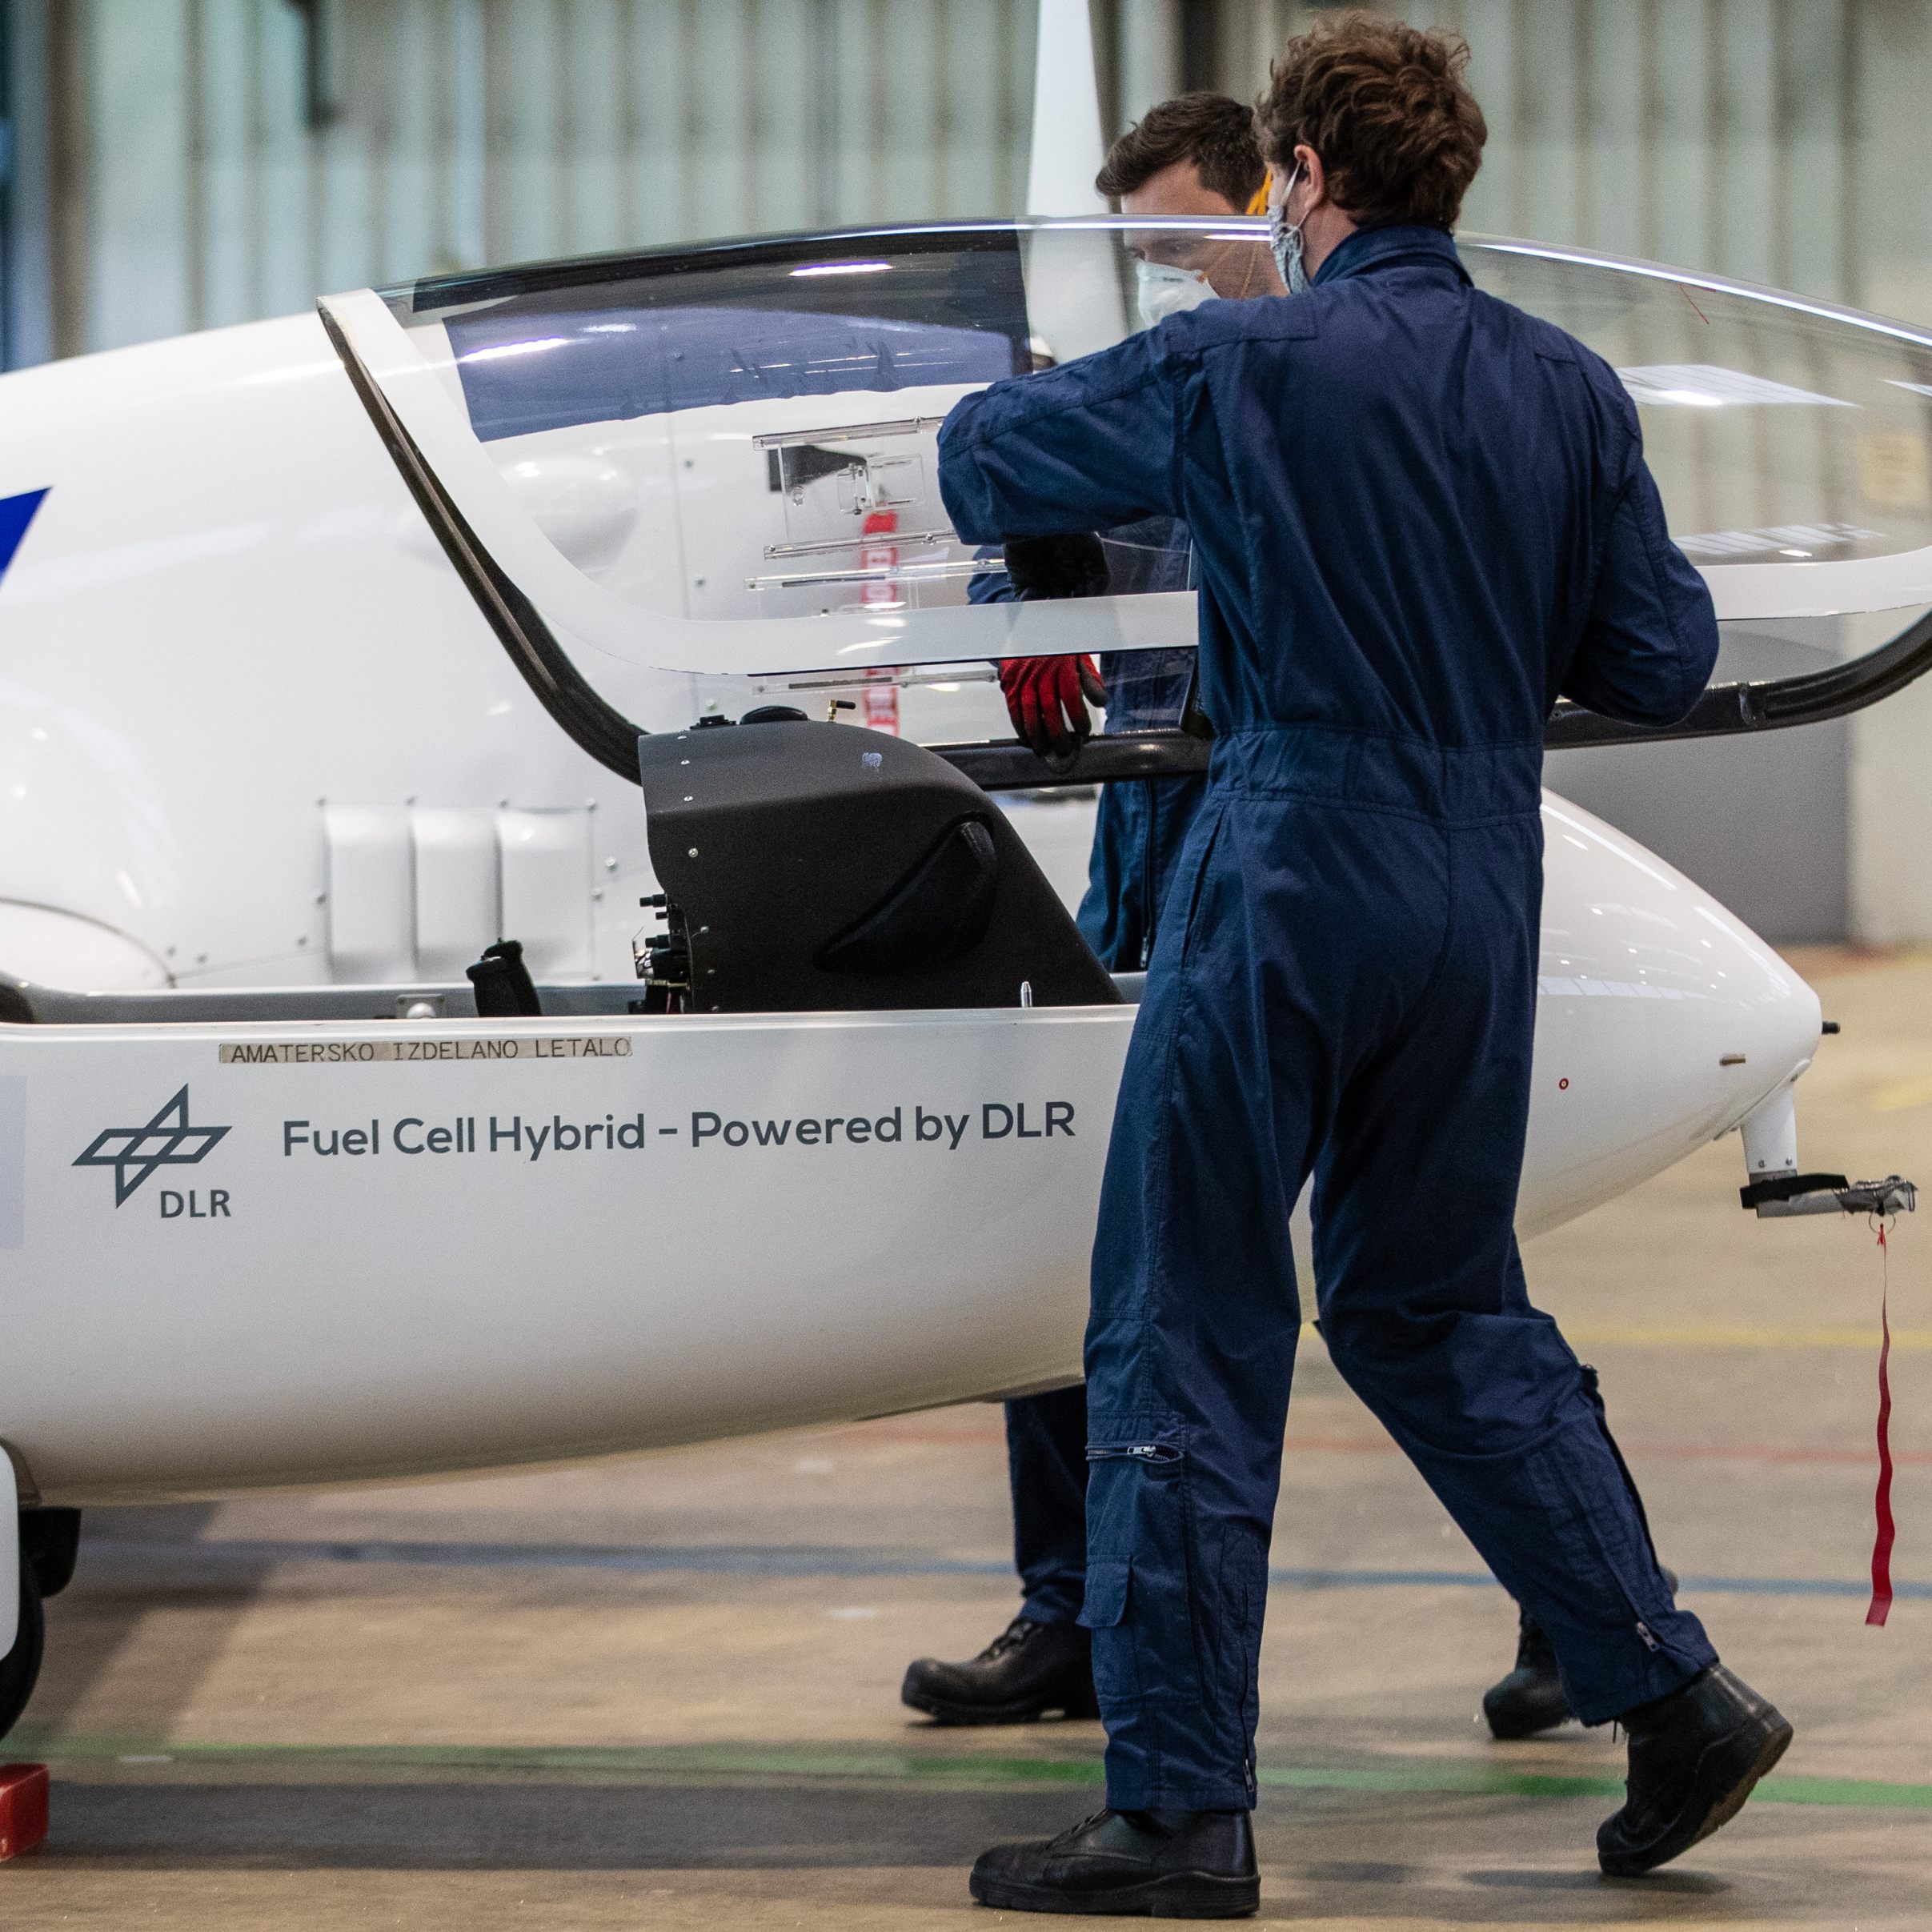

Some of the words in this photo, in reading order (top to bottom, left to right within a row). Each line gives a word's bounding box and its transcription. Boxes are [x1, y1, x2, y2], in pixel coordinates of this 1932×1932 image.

[230, 1043, 375, 1063] AMATERSKO
[393, 1040, 519, 1060] IZDELANO
[535, 1037, 631, 1058] LETALO
[283, 1119, 379, 1156] Fuel
[393, 1116, 475, 1155] Cell
[490, 1113, 645, 1161] Hybrid
[691, 1106, 902, 1148] Powered
[915, 1105, 971, 1151] by
[982, 1100, 1076, 1140] DLR
[160, 1189, 231, 1219] DLR
